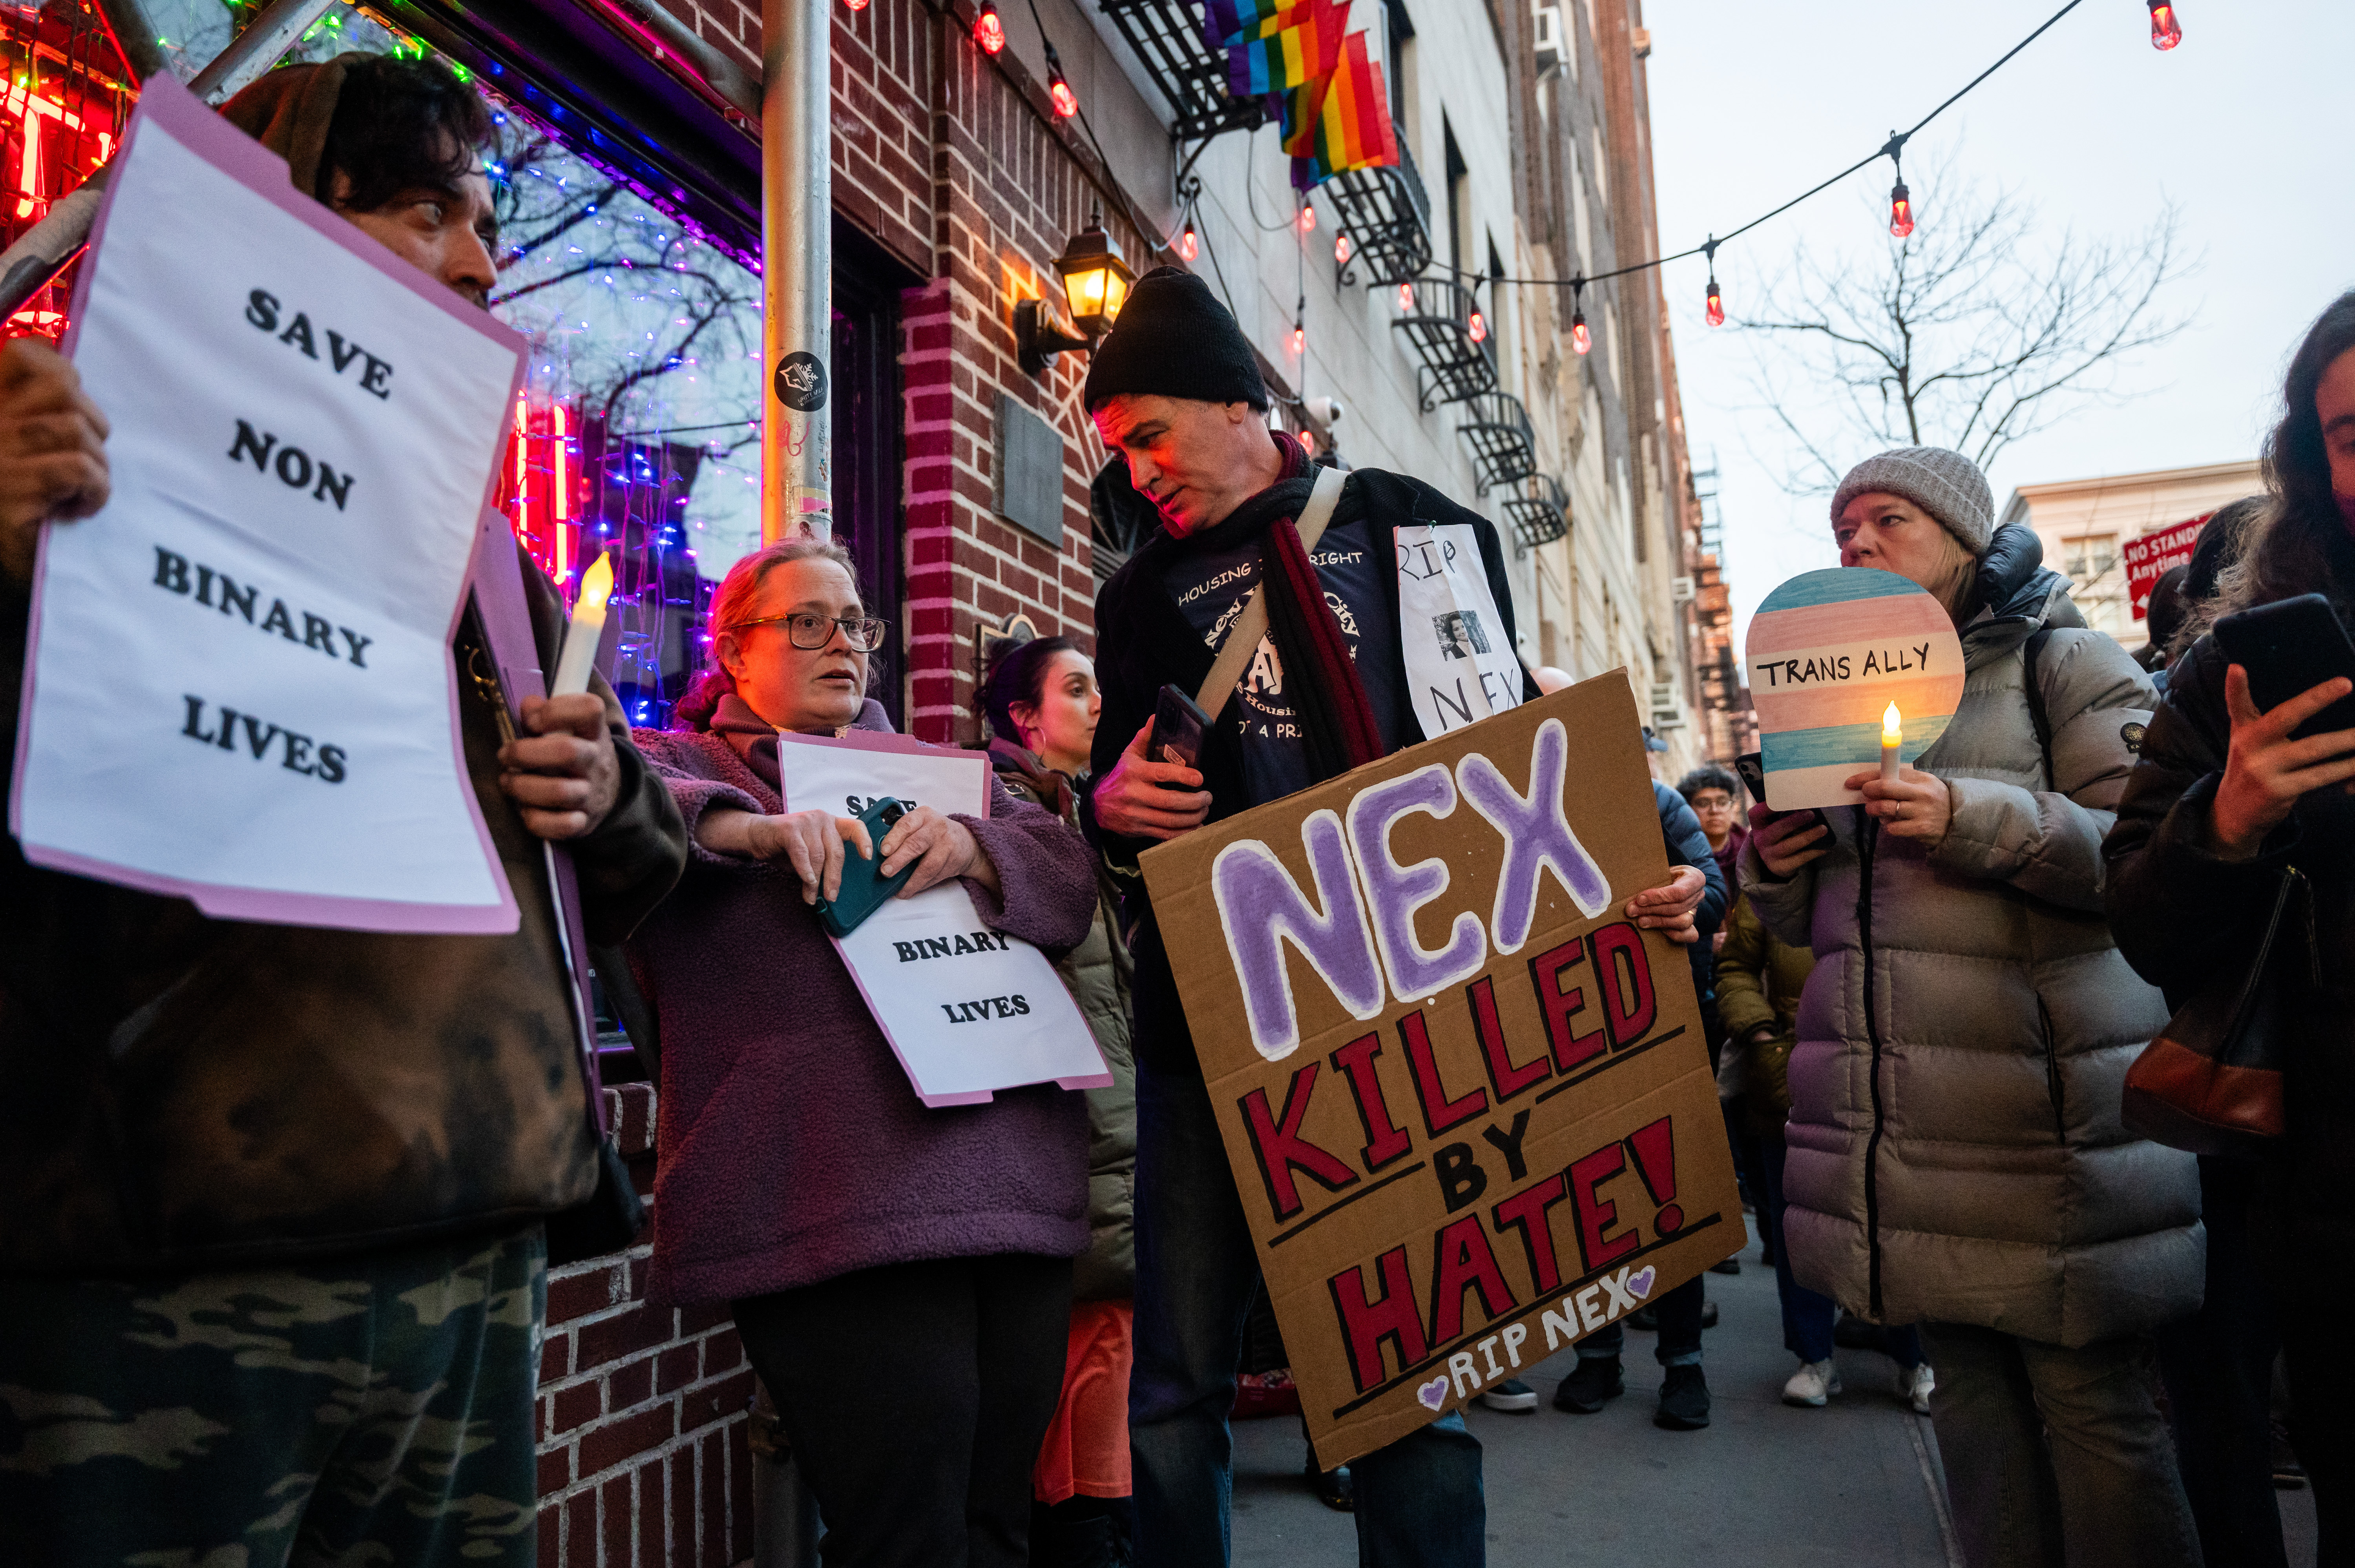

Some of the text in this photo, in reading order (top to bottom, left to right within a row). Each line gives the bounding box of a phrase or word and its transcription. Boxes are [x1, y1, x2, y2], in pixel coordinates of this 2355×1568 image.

[245, 288, 392, 400] SAVE
[228, 419, 355, 511] NON
[1309, 552, 1362, 566] RIGHT
[1398, 540, 1456, 581] RIP
[2128, 523, 2205, 564] NO STAND
[153, 545, 374, 668] BINARY
[1179, 563, 1251, 606] HOUSING
[1204, 597, 1242, 650] New
[1323, 592, 1360, 637] City
[1756, 642, 1929, 686] TRANS ALLY
[1245, 691, 1296, 716] Housi
[182, 694, 348, 784] LIVES
[1259, 725, 1268, 738] A
[1212, 717, 1612, 1062] NEX
[893, 931, 1010, 963] BINARY
[941, 994, 1030, 1023] LIVES
[1239, 920, 1658, 1223] KILLED
[1433, 1109, 1532, 1214] BY
[1329, 1116, 1686, 1393] HATE!
[1448, 1266, 1637, 1398] RIP NEX
